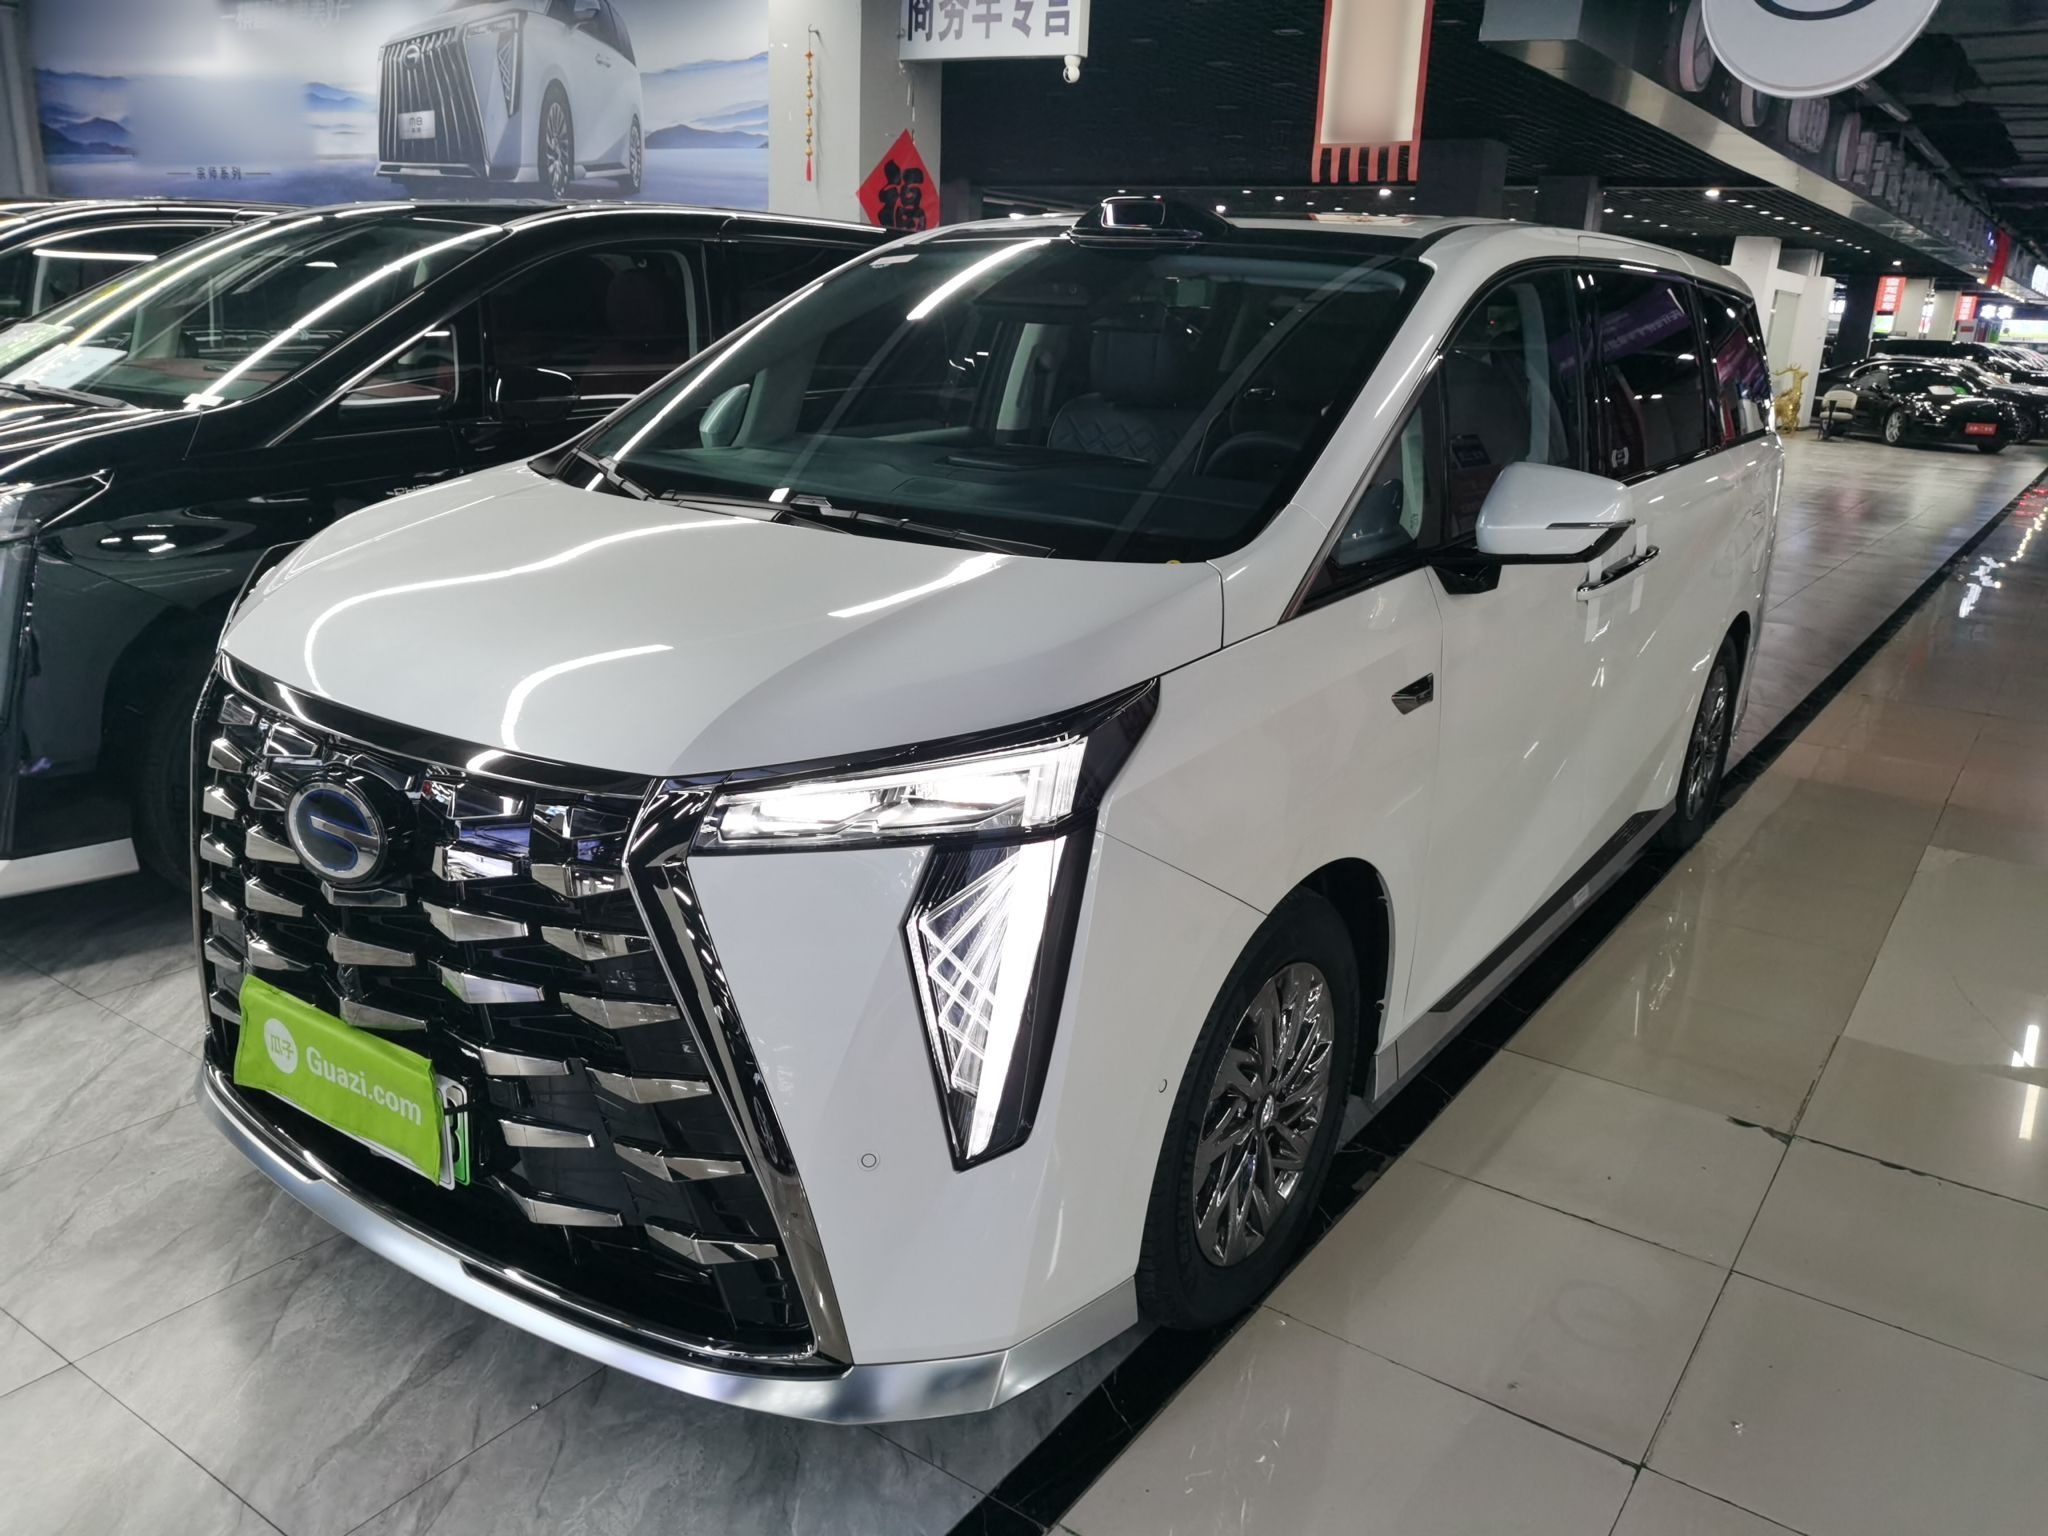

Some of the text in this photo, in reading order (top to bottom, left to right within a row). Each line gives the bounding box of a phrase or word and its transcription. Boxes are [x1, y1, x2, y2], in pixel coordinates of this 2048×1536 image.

[878, 159, 926, 232] 福
[270, 1034, 294, 1061] 瓜子
[306, 1046, 422, 1126] Guazi.com
